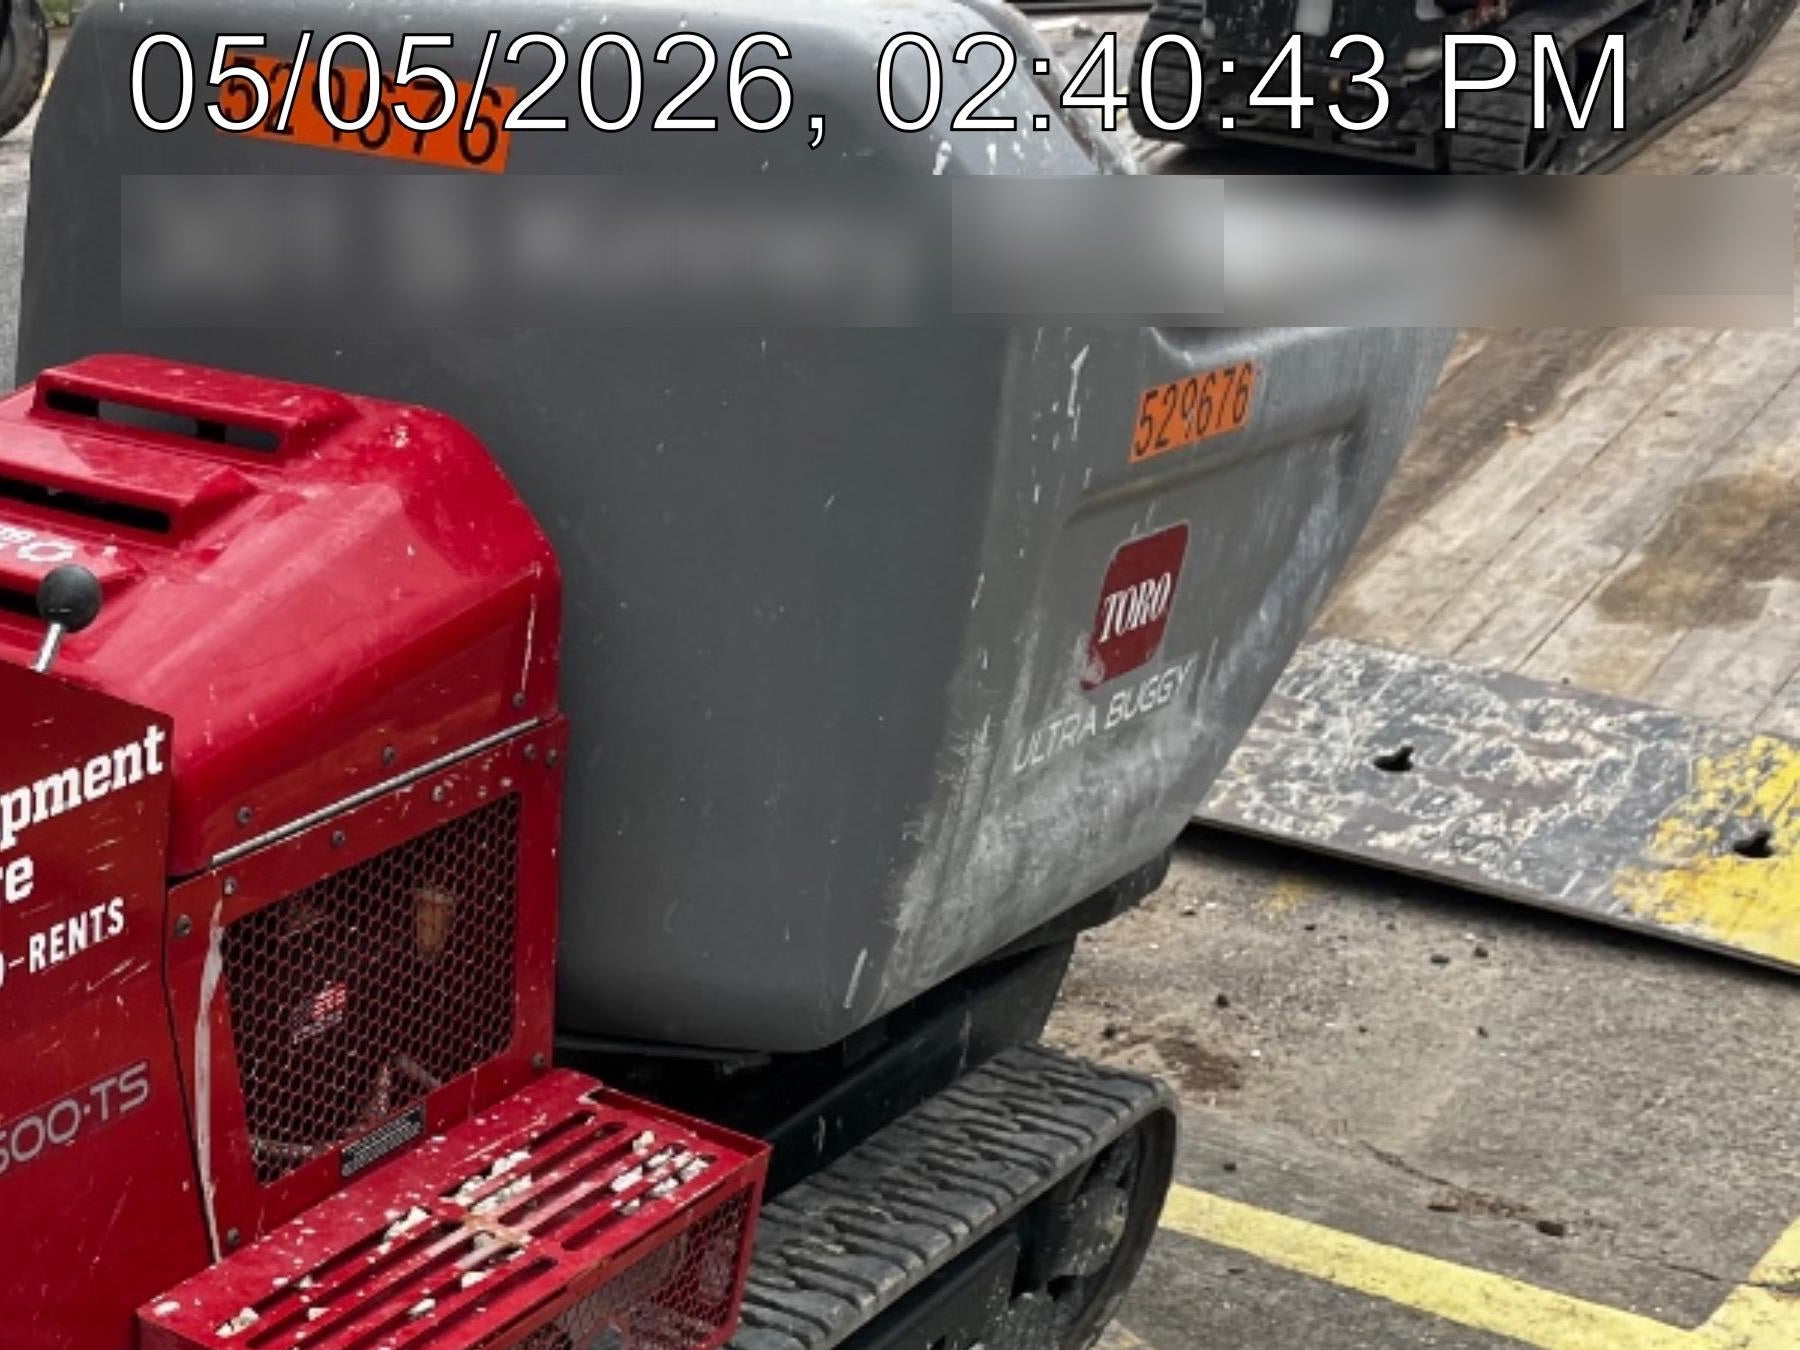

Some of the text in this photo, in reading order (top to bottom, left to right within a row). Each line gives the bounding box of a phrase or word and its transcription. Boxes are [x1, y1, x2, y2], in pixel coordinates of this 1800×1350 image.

[1135, 361, 1252, 457] 529676
[1098, 572, 1172, 643] TORO
[1012, 652, 1199, 775] ULTRA BUGGY
